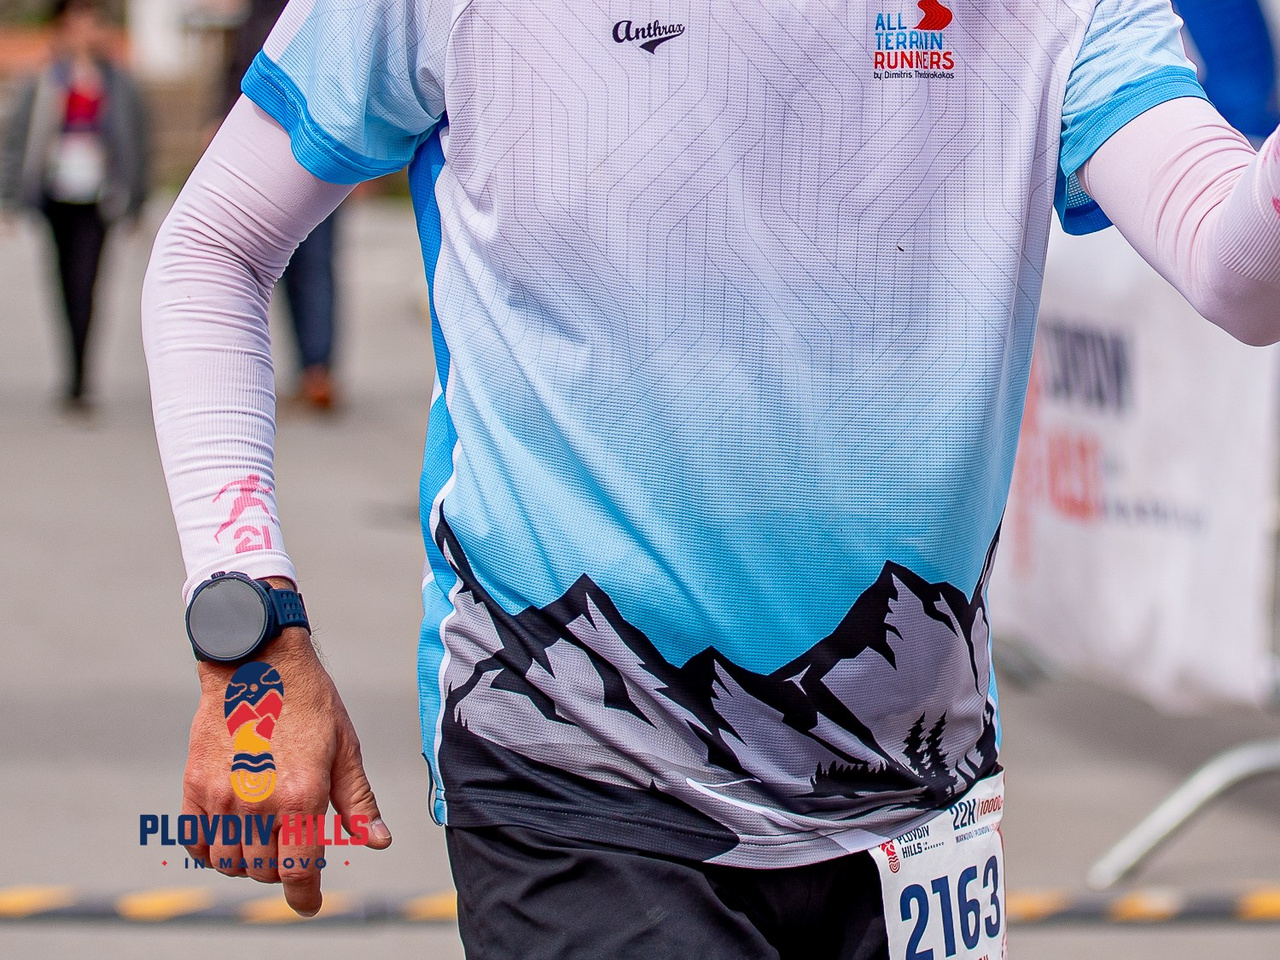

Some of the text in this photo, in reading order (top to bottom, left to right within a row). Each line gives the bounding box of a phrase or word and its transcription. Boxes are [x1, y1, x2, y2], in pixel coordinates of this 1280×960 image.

[612, 19, 686, 44] Anthrax
[875, 13, 907, 31] ALL
[875, 30, 943, 50] TERRAIN
[874, 51, 955, 70] RUNNERS
[873, 71, 882, 80] by
[884, 70, 913, 79] Dimitris
[233, 525, 272, 554] 21
[896, 824, 930, 845] PLOVDIV
[901, 842, 923, 859] HILLS
[899, 855, 1001, 960] 2163
